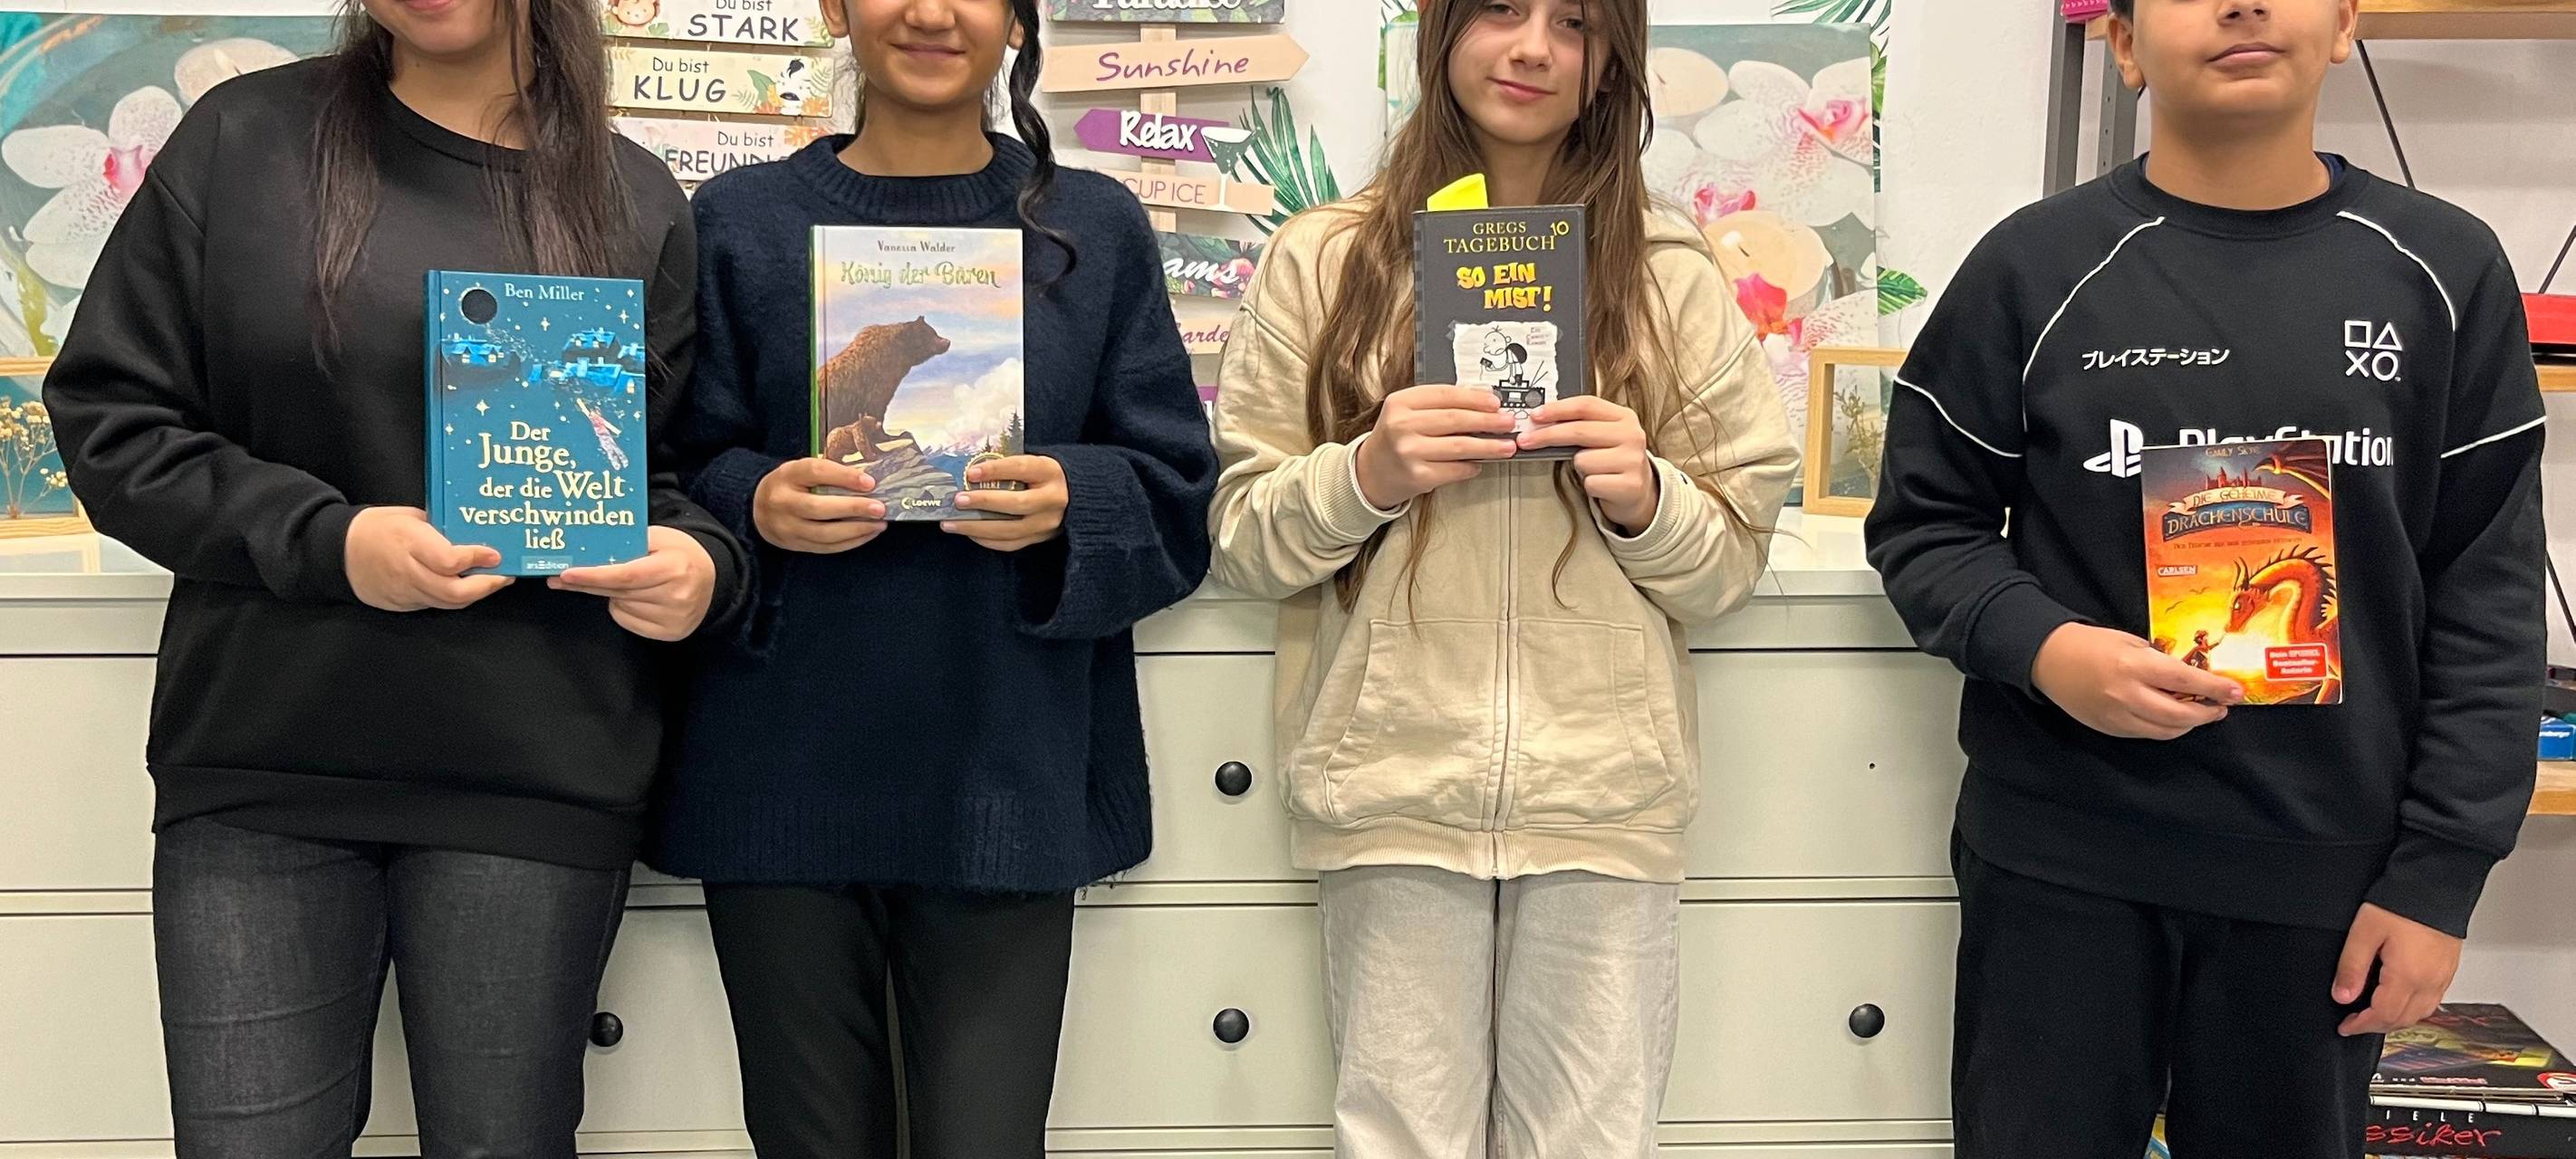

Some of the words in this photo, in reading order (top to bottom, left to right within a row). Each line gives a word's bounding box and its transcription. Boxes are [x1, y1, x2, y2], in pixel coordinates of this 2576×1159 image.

[743, 0, 772, 11] bist
[687, 14, 799, 42] STARK
[652, 57, 673, 72] Du
[679, 59, 709, 73] bist
[1096, 49, 1249, 81] Sunshine
[634, 75, 726, 102] KLUG
[717, 130, 738, 146] Du
[744, 132, 774, 147] bist
[1120, 110, 1197, 152] Relax
[1172, 182, 1206, 205] ICE
[1473, 221, 1527, 235] GREGS
[1550, 221, 1569, 236] 10
[878, 240, 917, 252] Vanessa
[919, 241, 956, 253] Walder
[1444, 235, 1556, 254] TAGEBUCH
[841, 261, 892, 289] König
[899, 262, 930, 285] der
[934, 261, 1001, 288] Bären
[1456, 266, 1486, 289] SO
[1493, 262, 1536, 285] EIN
[505, 283, 533, 299] Ben
[539, 284, 584, 302] Miller
[1484, 285, 1552, 311] MIST!
[2081, 347, 2230, 370] プレイステーション
[510, 421, 551, 441] Der
[478, 433, 577, 473] Junge,
[479, 477, 514, 498] der
[520, 478, 552, 498] die
[553, 469, 626, 500] Welt
[2194, 494, 2212, 506] DIE
[2220, 490, 2276, 500] GEHEIME
[459, 501, 635, 526] verschwinden
[2167, 506, 2309, 534] DRACHENSCHULE
[524, 528, 566, 550] ließ
[2158, 565, 2196, 576] CARLSEN
